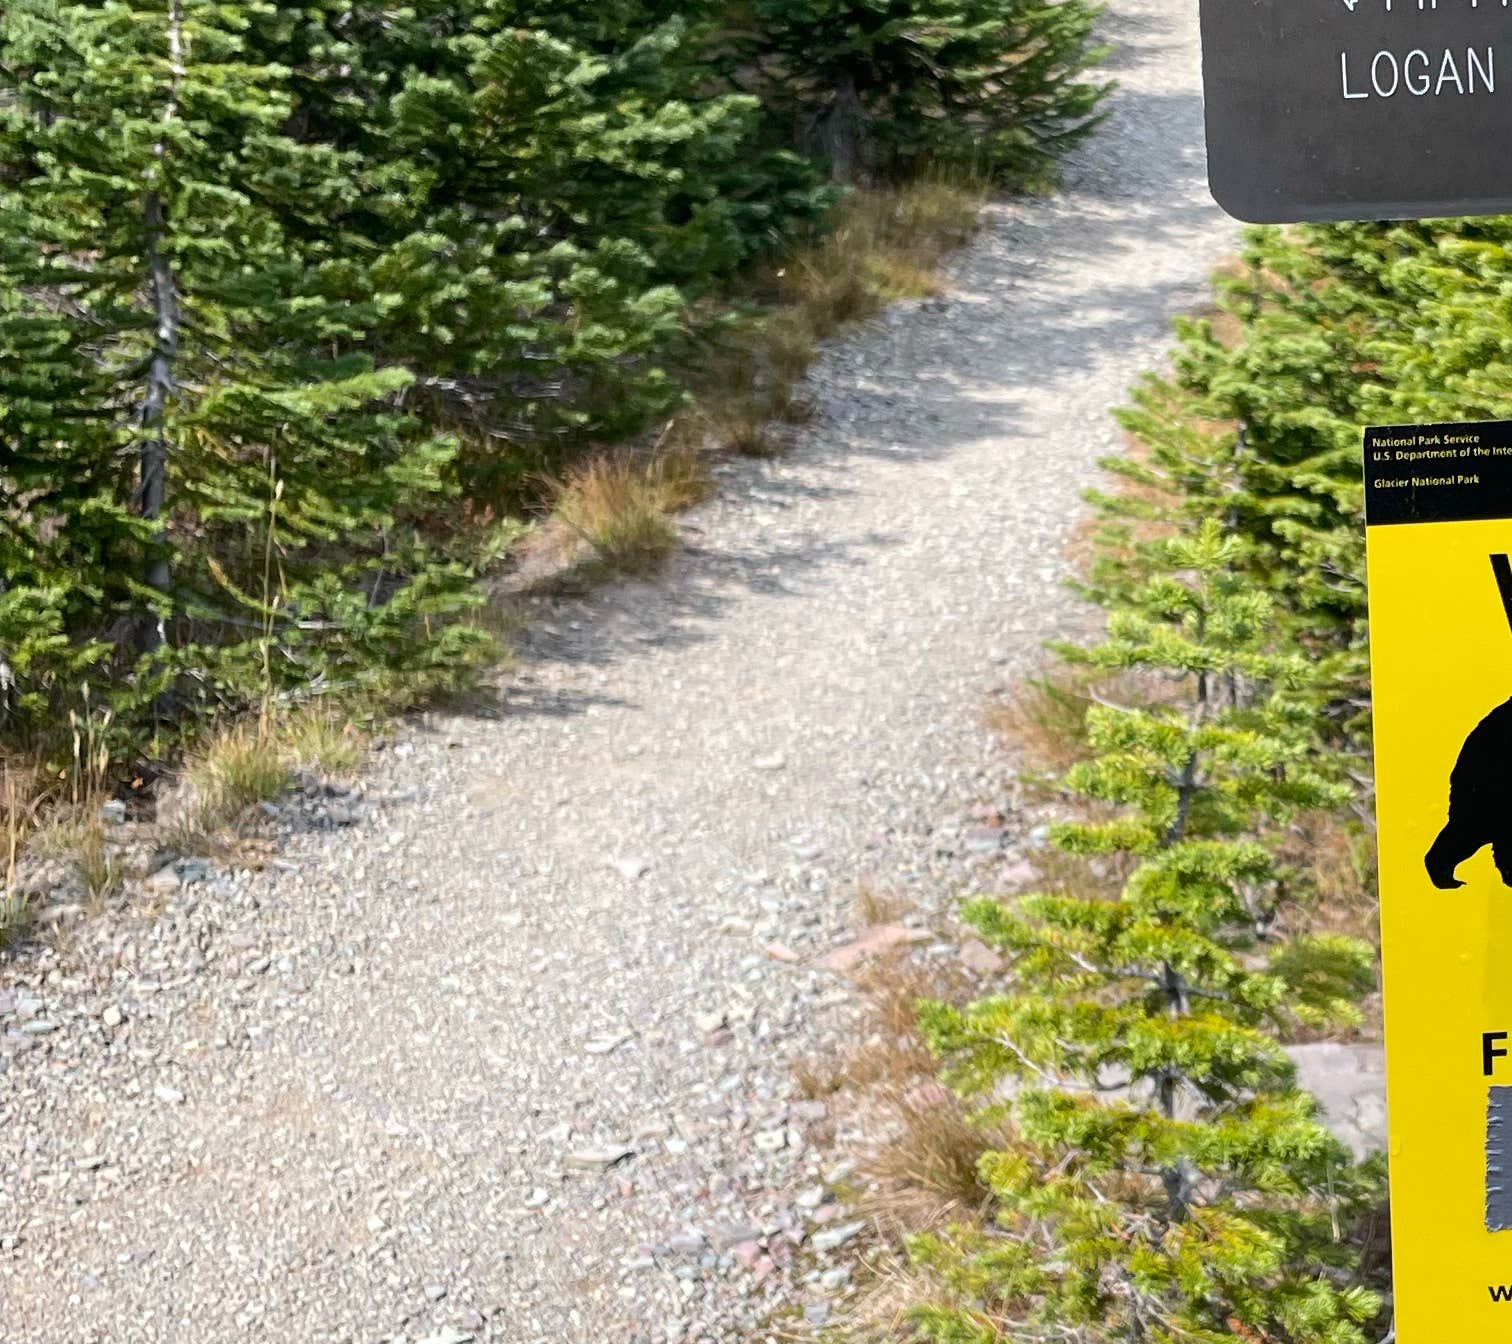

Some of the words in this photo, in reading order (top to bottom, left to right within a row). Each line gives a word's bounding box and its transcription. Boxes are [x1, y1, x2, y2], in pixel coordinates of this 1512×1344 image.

[1341, 46, 1495, 99] LOGAN
[1372, 436, 1416, 447] National
[1419, 435, 1441, 446] Park
[1444, 434, 1480, 445] Service
[1373, 451, 1393, 461] U.S.
[1396, 449, 1457, 462] Department
[1459, 447, 1471, 457] of
[1473, 446, 1491, 457] the
[1374, 478, 1409, 489] Glacier
[1412, 475, 1455, 487] National
[1458, 475, 1480, 485] Park
